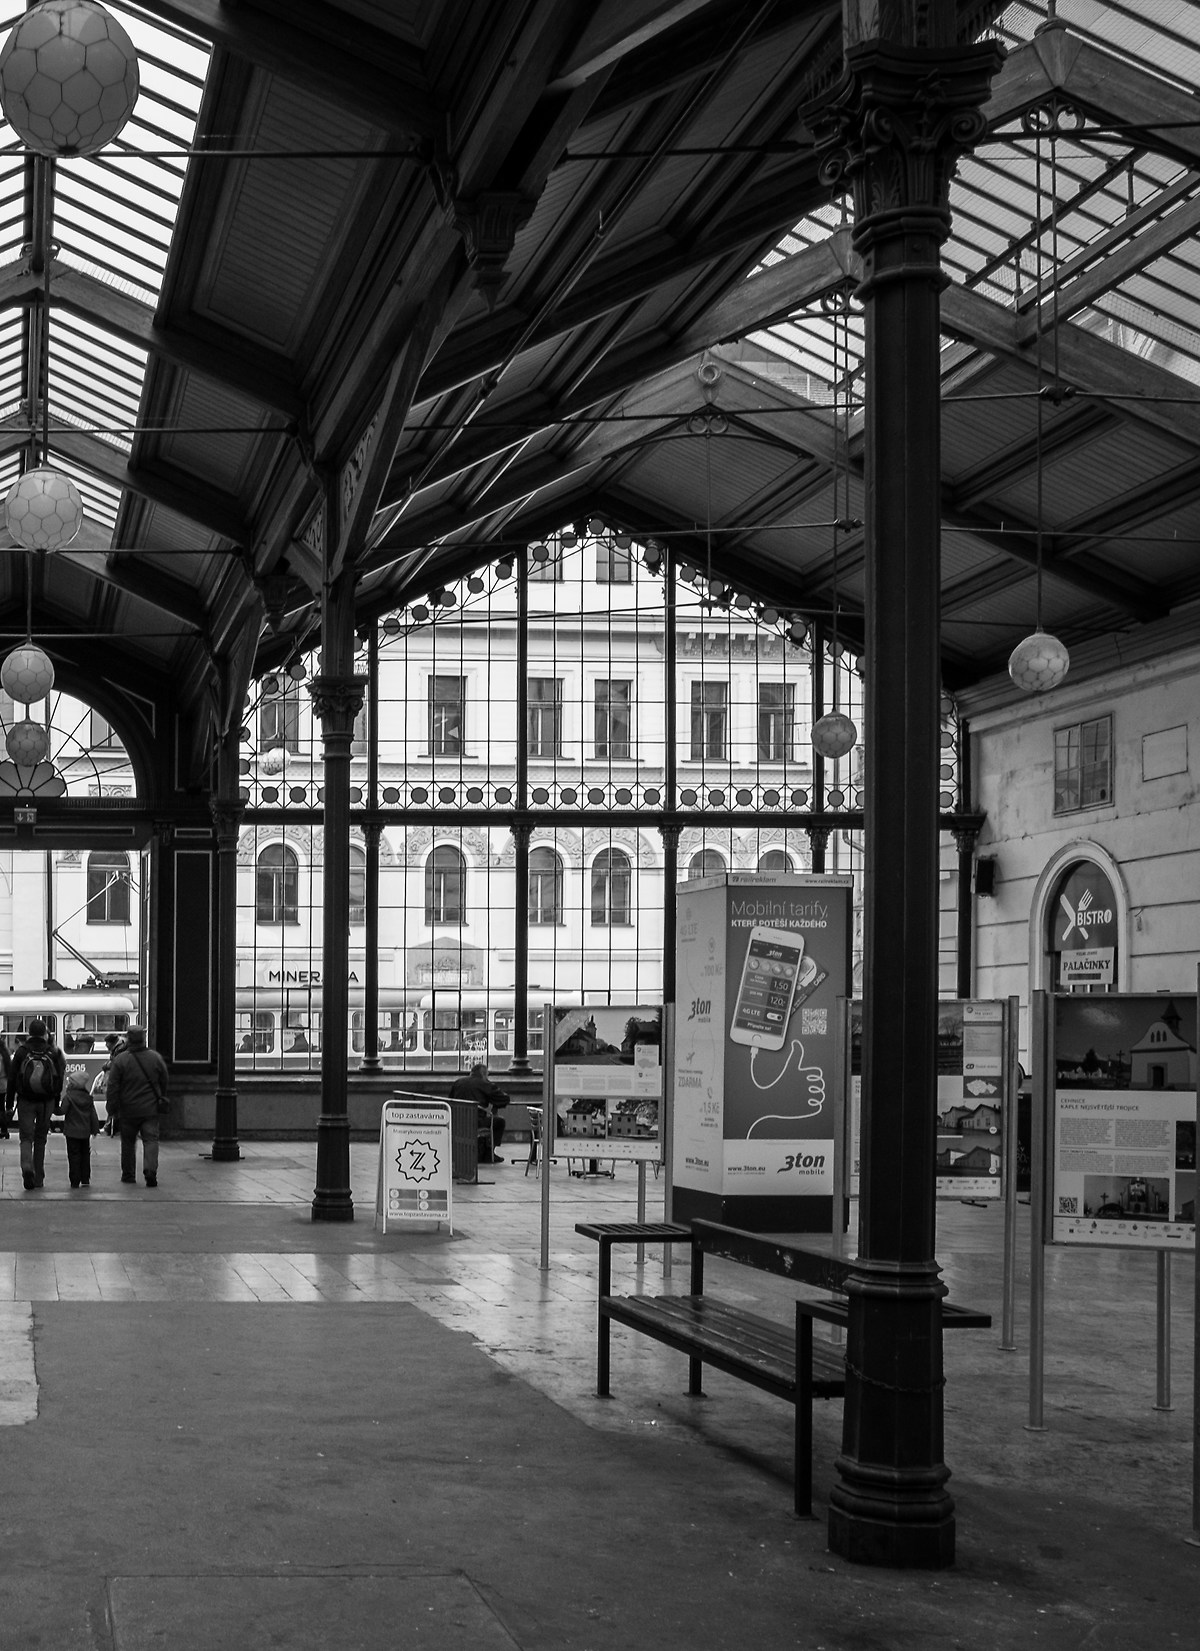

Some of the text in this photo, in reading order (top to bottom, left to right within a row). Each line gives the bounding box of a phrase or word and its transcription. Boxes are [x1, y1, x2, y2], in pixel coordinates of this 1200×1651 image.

[731, 900, 828, 919] Mobilní tarify,
[731, 918, 827, 928] KTERÉ POTĚŠÍ KAŽDÉHO
[1077, 909, 1112, 926] BISTRO
[1063, 958, 1111, 971] PALAČINKY
[687, 997, 711, 1021] 3ton
[678, 1076, 702, 1088] ZDARMA
[405, 1112, 445, 1120] zastavárna
[777, 1152, 825, 1174] 3ton
